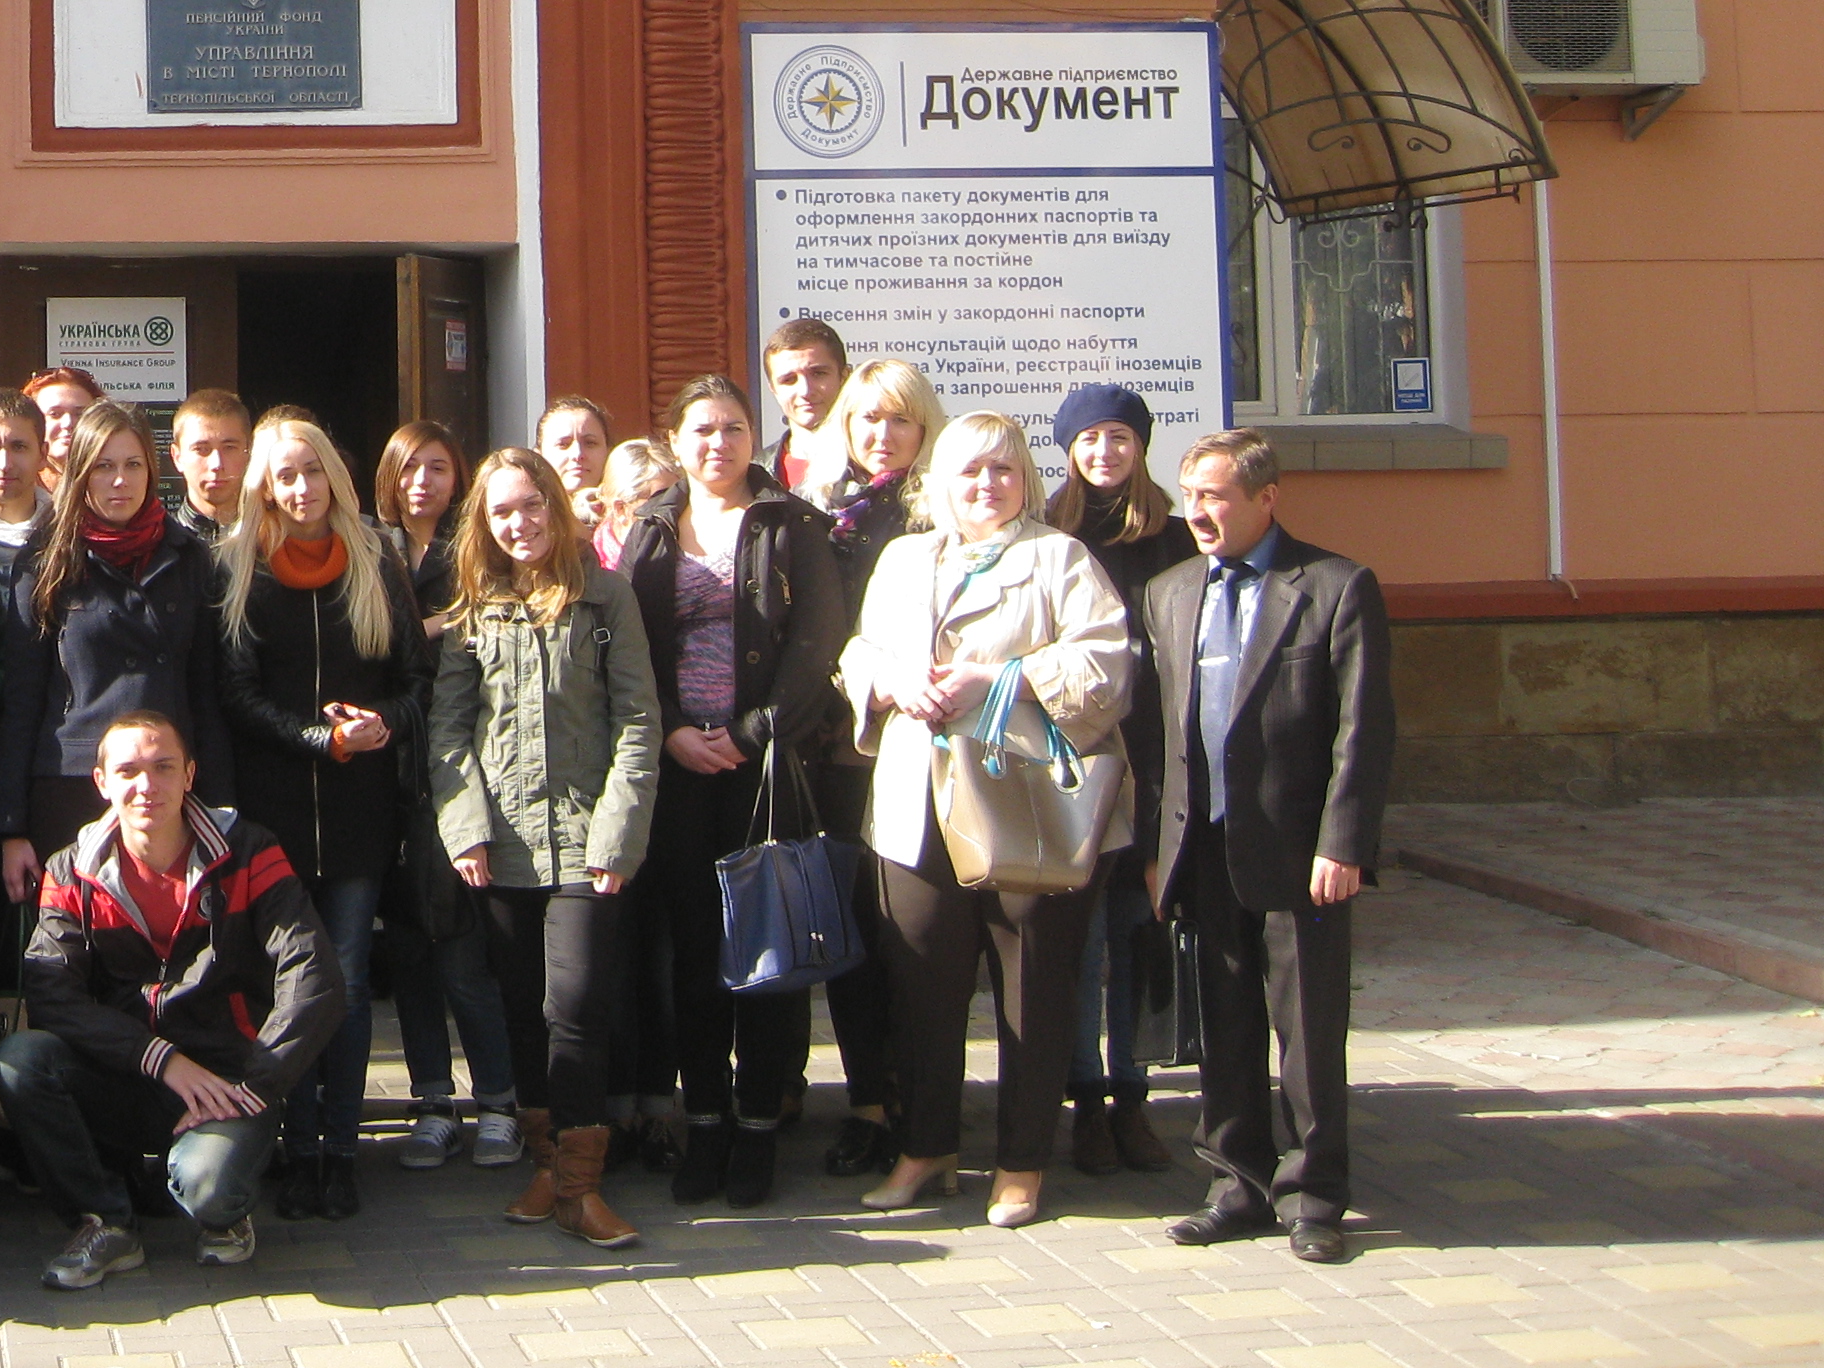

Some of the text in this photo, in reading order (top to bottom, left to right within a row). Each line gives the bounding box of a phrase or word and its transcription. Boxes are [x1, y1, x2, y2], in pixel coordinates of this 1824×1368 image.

[186, 11, 322, 24] ПЕНСІЙНИЙ ФОНД
[196, 46, 313, 60] УПРАВЛІННЯ
[164, 65, 346, 79] В МІСТІ ТЕРНОПОЛІ
[962, 67, 1178, 84] Державне підприємство
[289, 92, 348, 103] ОБЛАСТІ
[921, 76, 1179, 131] Документ
[795, 187, 1109, 206] Підготовка пакету документів для
[796, 209, 1158, 227] оформлення закордонних паспортів та
[796, 230, 1170, 249] дитячих проїзних документів для виїзду
[797, 252, 1032, 269] на тимчасове та постійне
[797, 274, 1063, 292] місце проживання за кордон
[799, 305, 1145, 323] Внесення змін у закордонні паспорти
[59, 321, 140, 338] УКРАЇНСЬКА
[885, 335, 1006, 355] консультацій
[1012, 336, 1061, 352] щодо
[1067, 334, 1138, 352] набуття
[936, 357, 1010, 375] України,
[1016, 355, 1110, 375] реєстрації
[1115, 355, 1202, 373] іноземців
[147, 382, 174, 390] ФІЛІЯ
[950, 378, 1062, 397] запрошення
